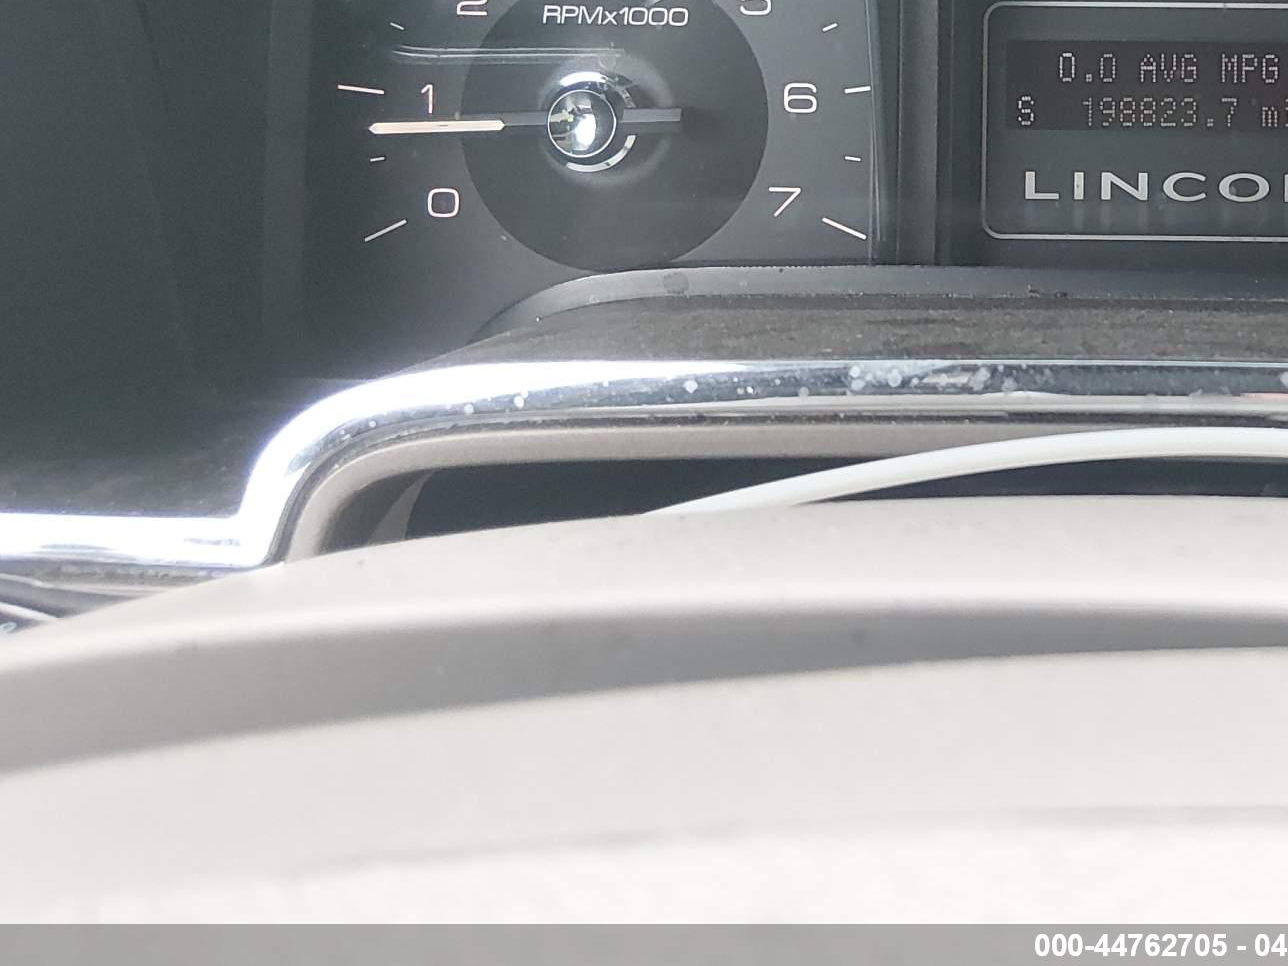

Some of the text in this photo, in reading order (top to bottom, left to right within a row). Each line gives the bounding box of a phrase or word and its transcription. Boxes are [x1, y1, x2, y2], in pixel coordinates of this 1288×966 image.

[543, 5, 688, 26] RPMx1000
[1059, 53, 1280, 83] 0.0 AVG MPG
[421, 85, 432, 113] 1
[784, 83, 817, 113] 6
[1017, 96, 1034, 125] S
[1082, 97, 1237, 127] 198823.7
[428, 188, 459, 217] 0
[769, 187, 801, 216] 7
